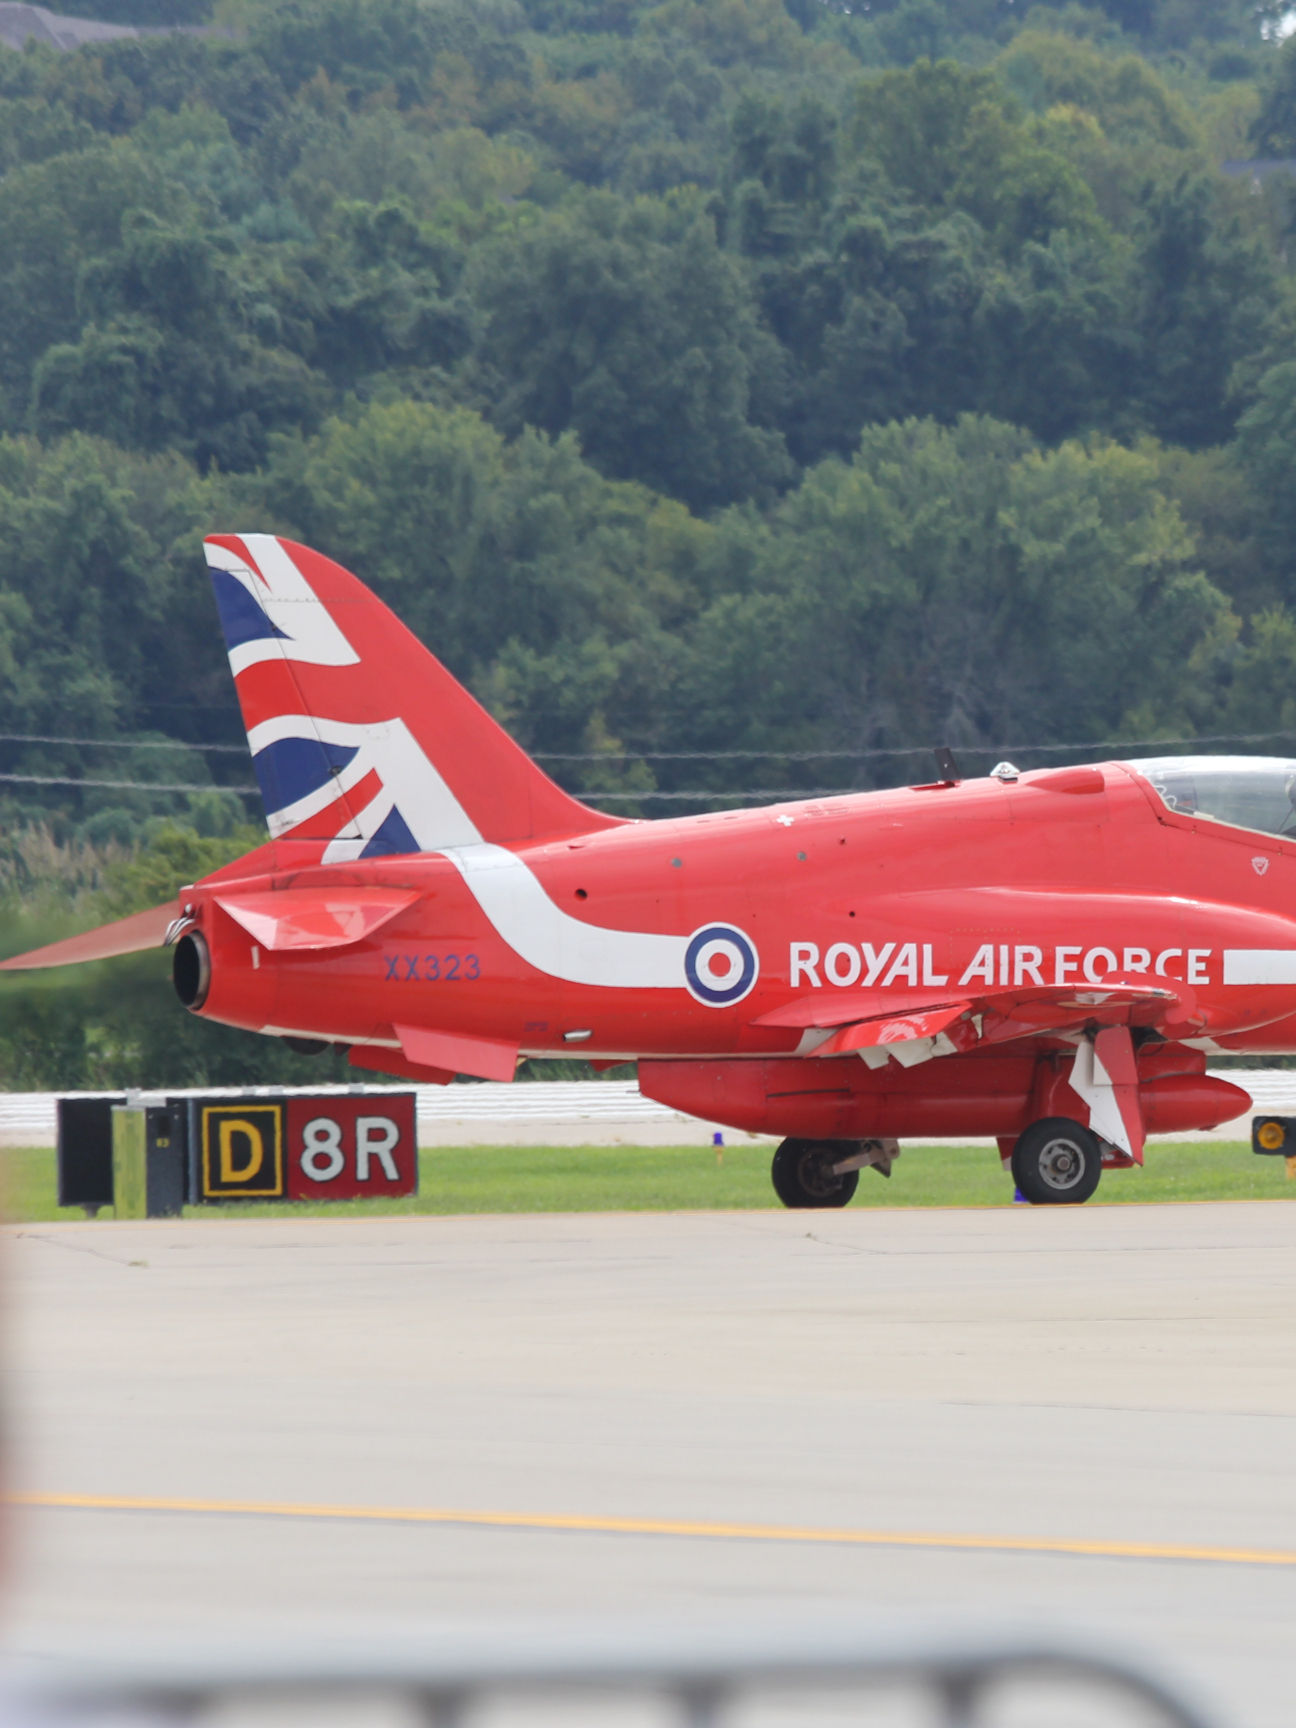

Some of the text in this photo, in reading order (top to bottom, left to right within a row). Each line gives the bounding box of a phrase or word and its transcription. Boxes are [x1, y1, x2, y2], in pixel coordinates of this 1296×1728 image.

[384, 953, 481, 981] XX323
[789, 941, 949, 988] ROYAL
[958, 943, 1045, 986] AIR
[220, 1116, 399, 1182] D 8R
